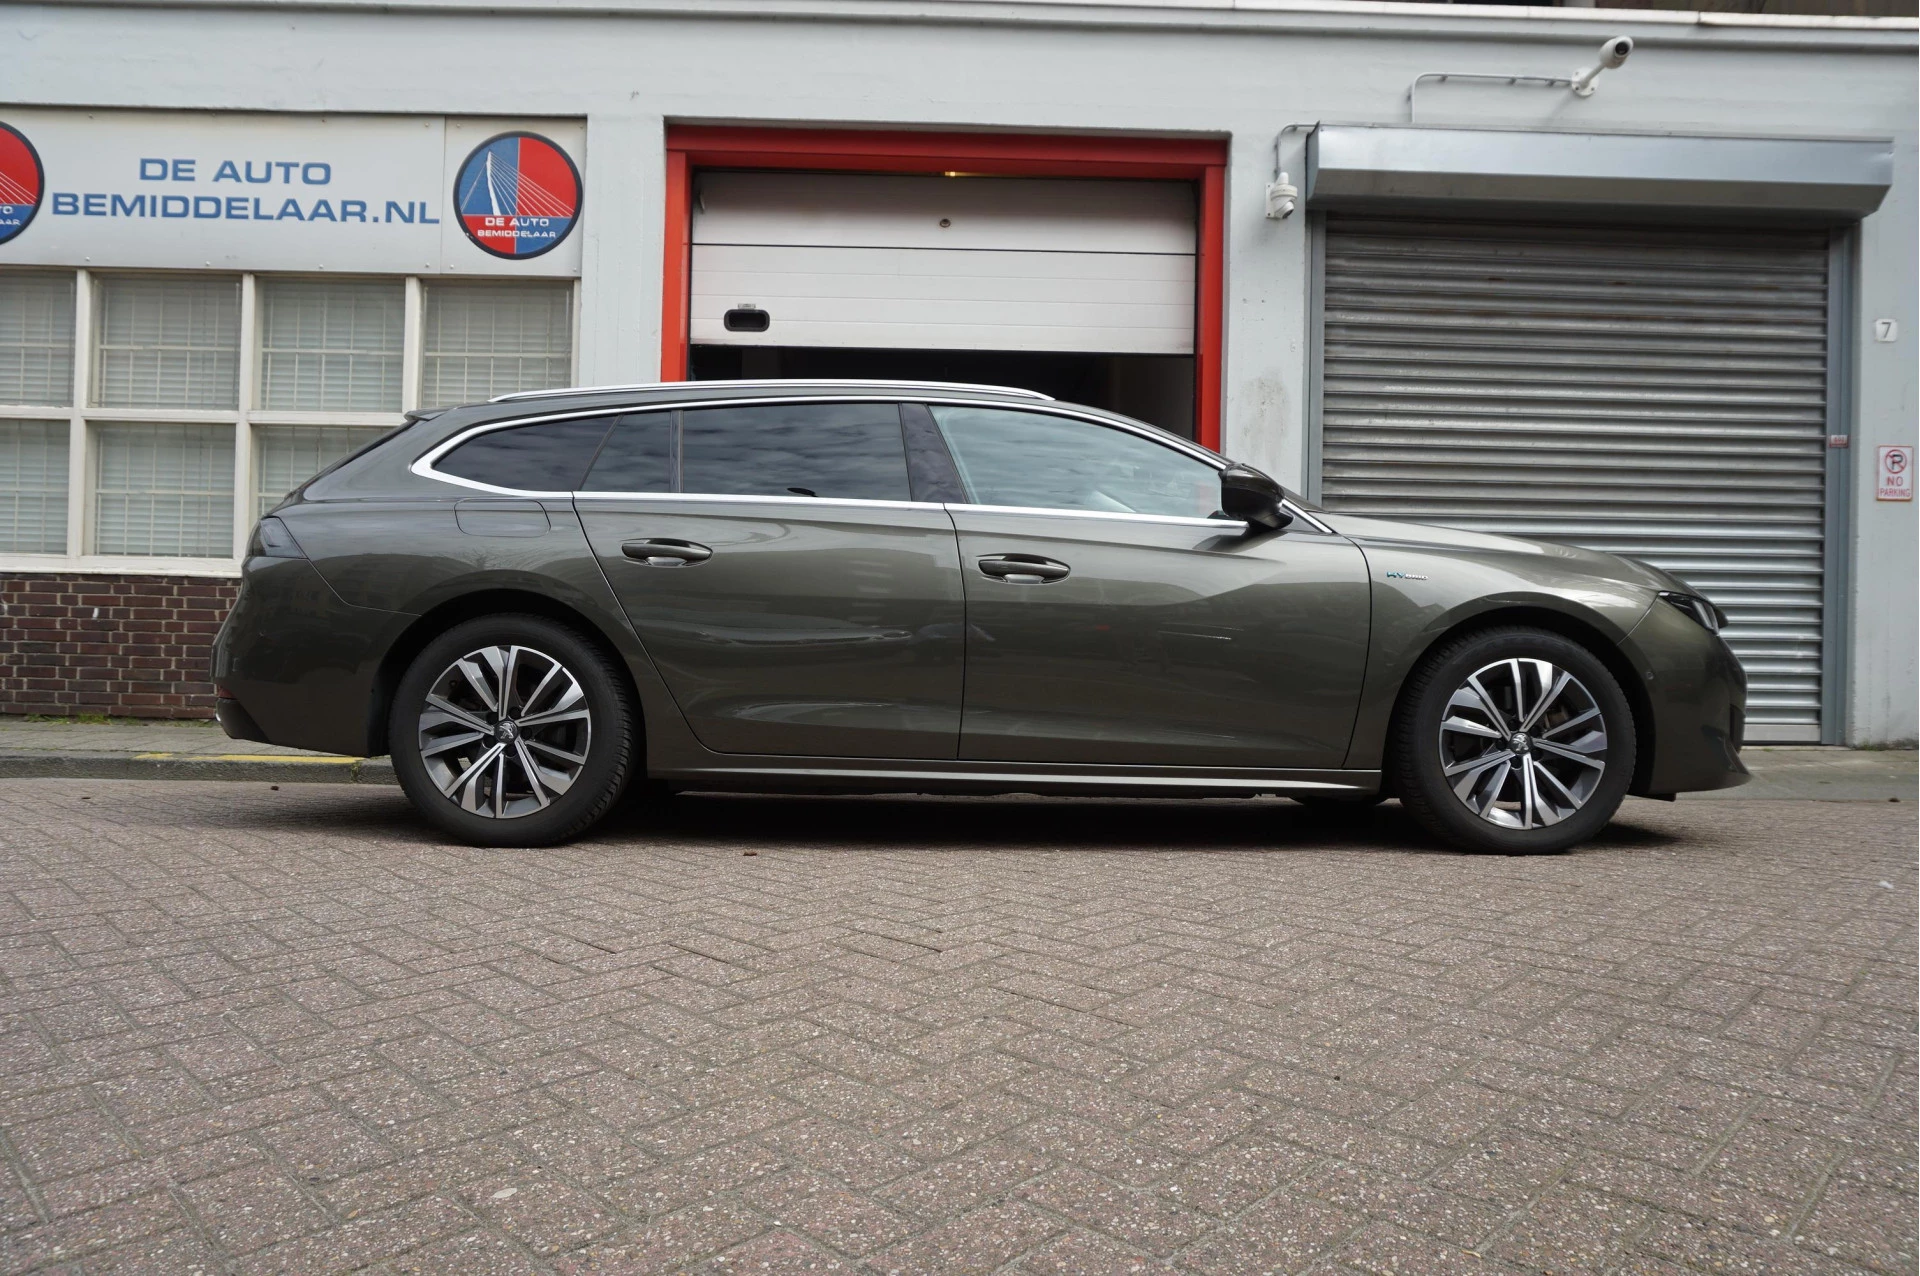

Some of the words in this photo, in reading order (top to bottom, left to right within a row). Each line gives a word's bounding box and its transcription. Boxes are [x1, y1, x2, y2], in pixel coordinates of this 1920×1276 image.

[139, 158, 196, 182] DE
[212, 160, 332, 185] AUTO
[52, 192, 440, 225] BEMIDDELAAR.NL
[485, 217, 505, 227] DE
[509, 218, 549, 227] AUTO
[477, 229, 556, 238] BEMIDDELAAR
[1881, 321, 1891, 339] 7
[1886, 475, 1904, 487] NO
[1879, 487, 1911, 498] PARKING
